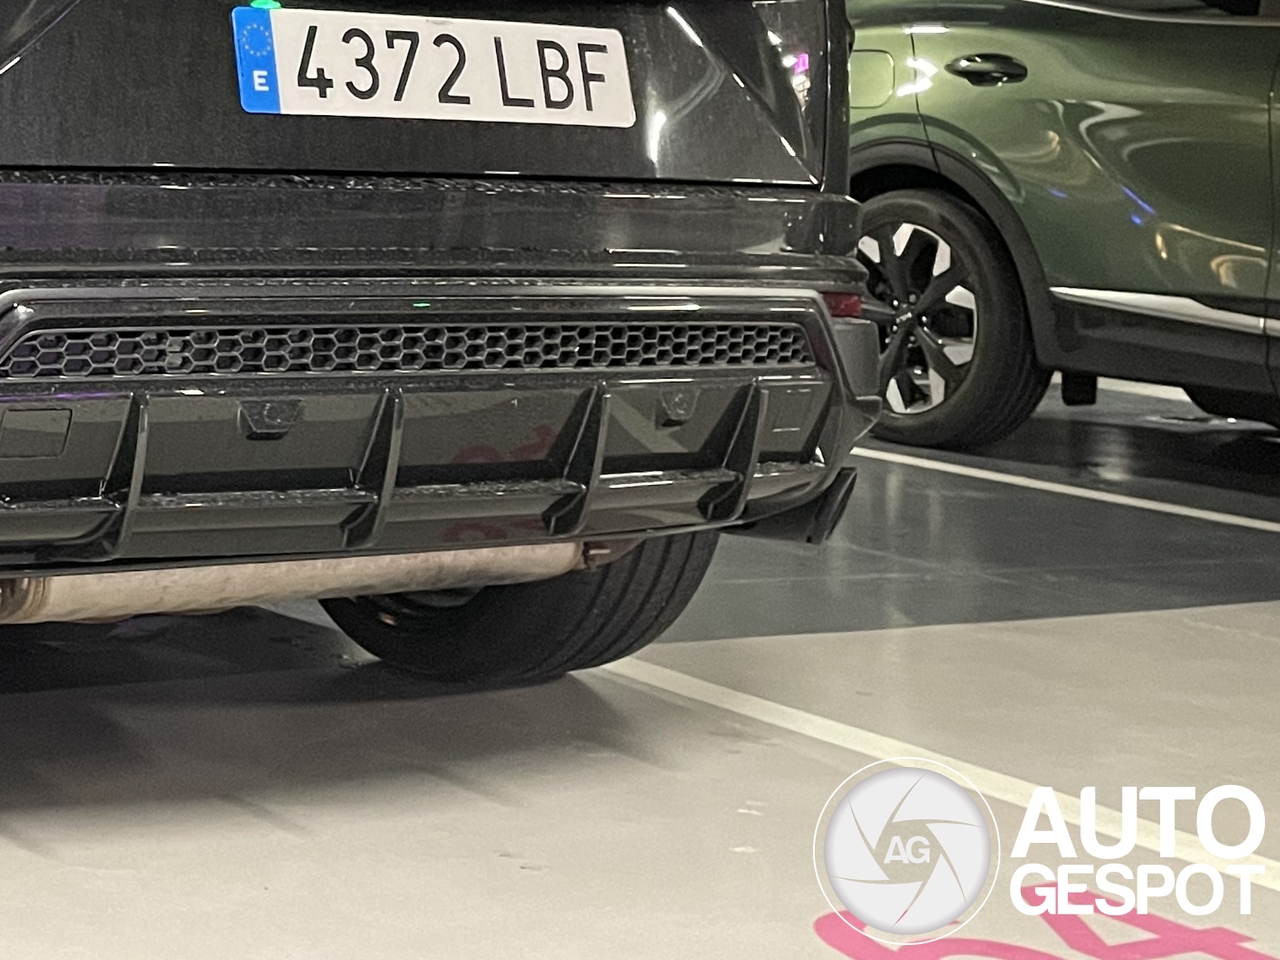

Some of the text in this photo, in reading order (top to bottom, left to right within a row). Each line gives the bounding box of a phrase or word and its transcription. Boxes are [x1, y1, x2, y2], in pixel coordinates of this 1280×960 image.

[252, 70, 270, 92] E
[297, 24, 609, 112] 4372 LBF
